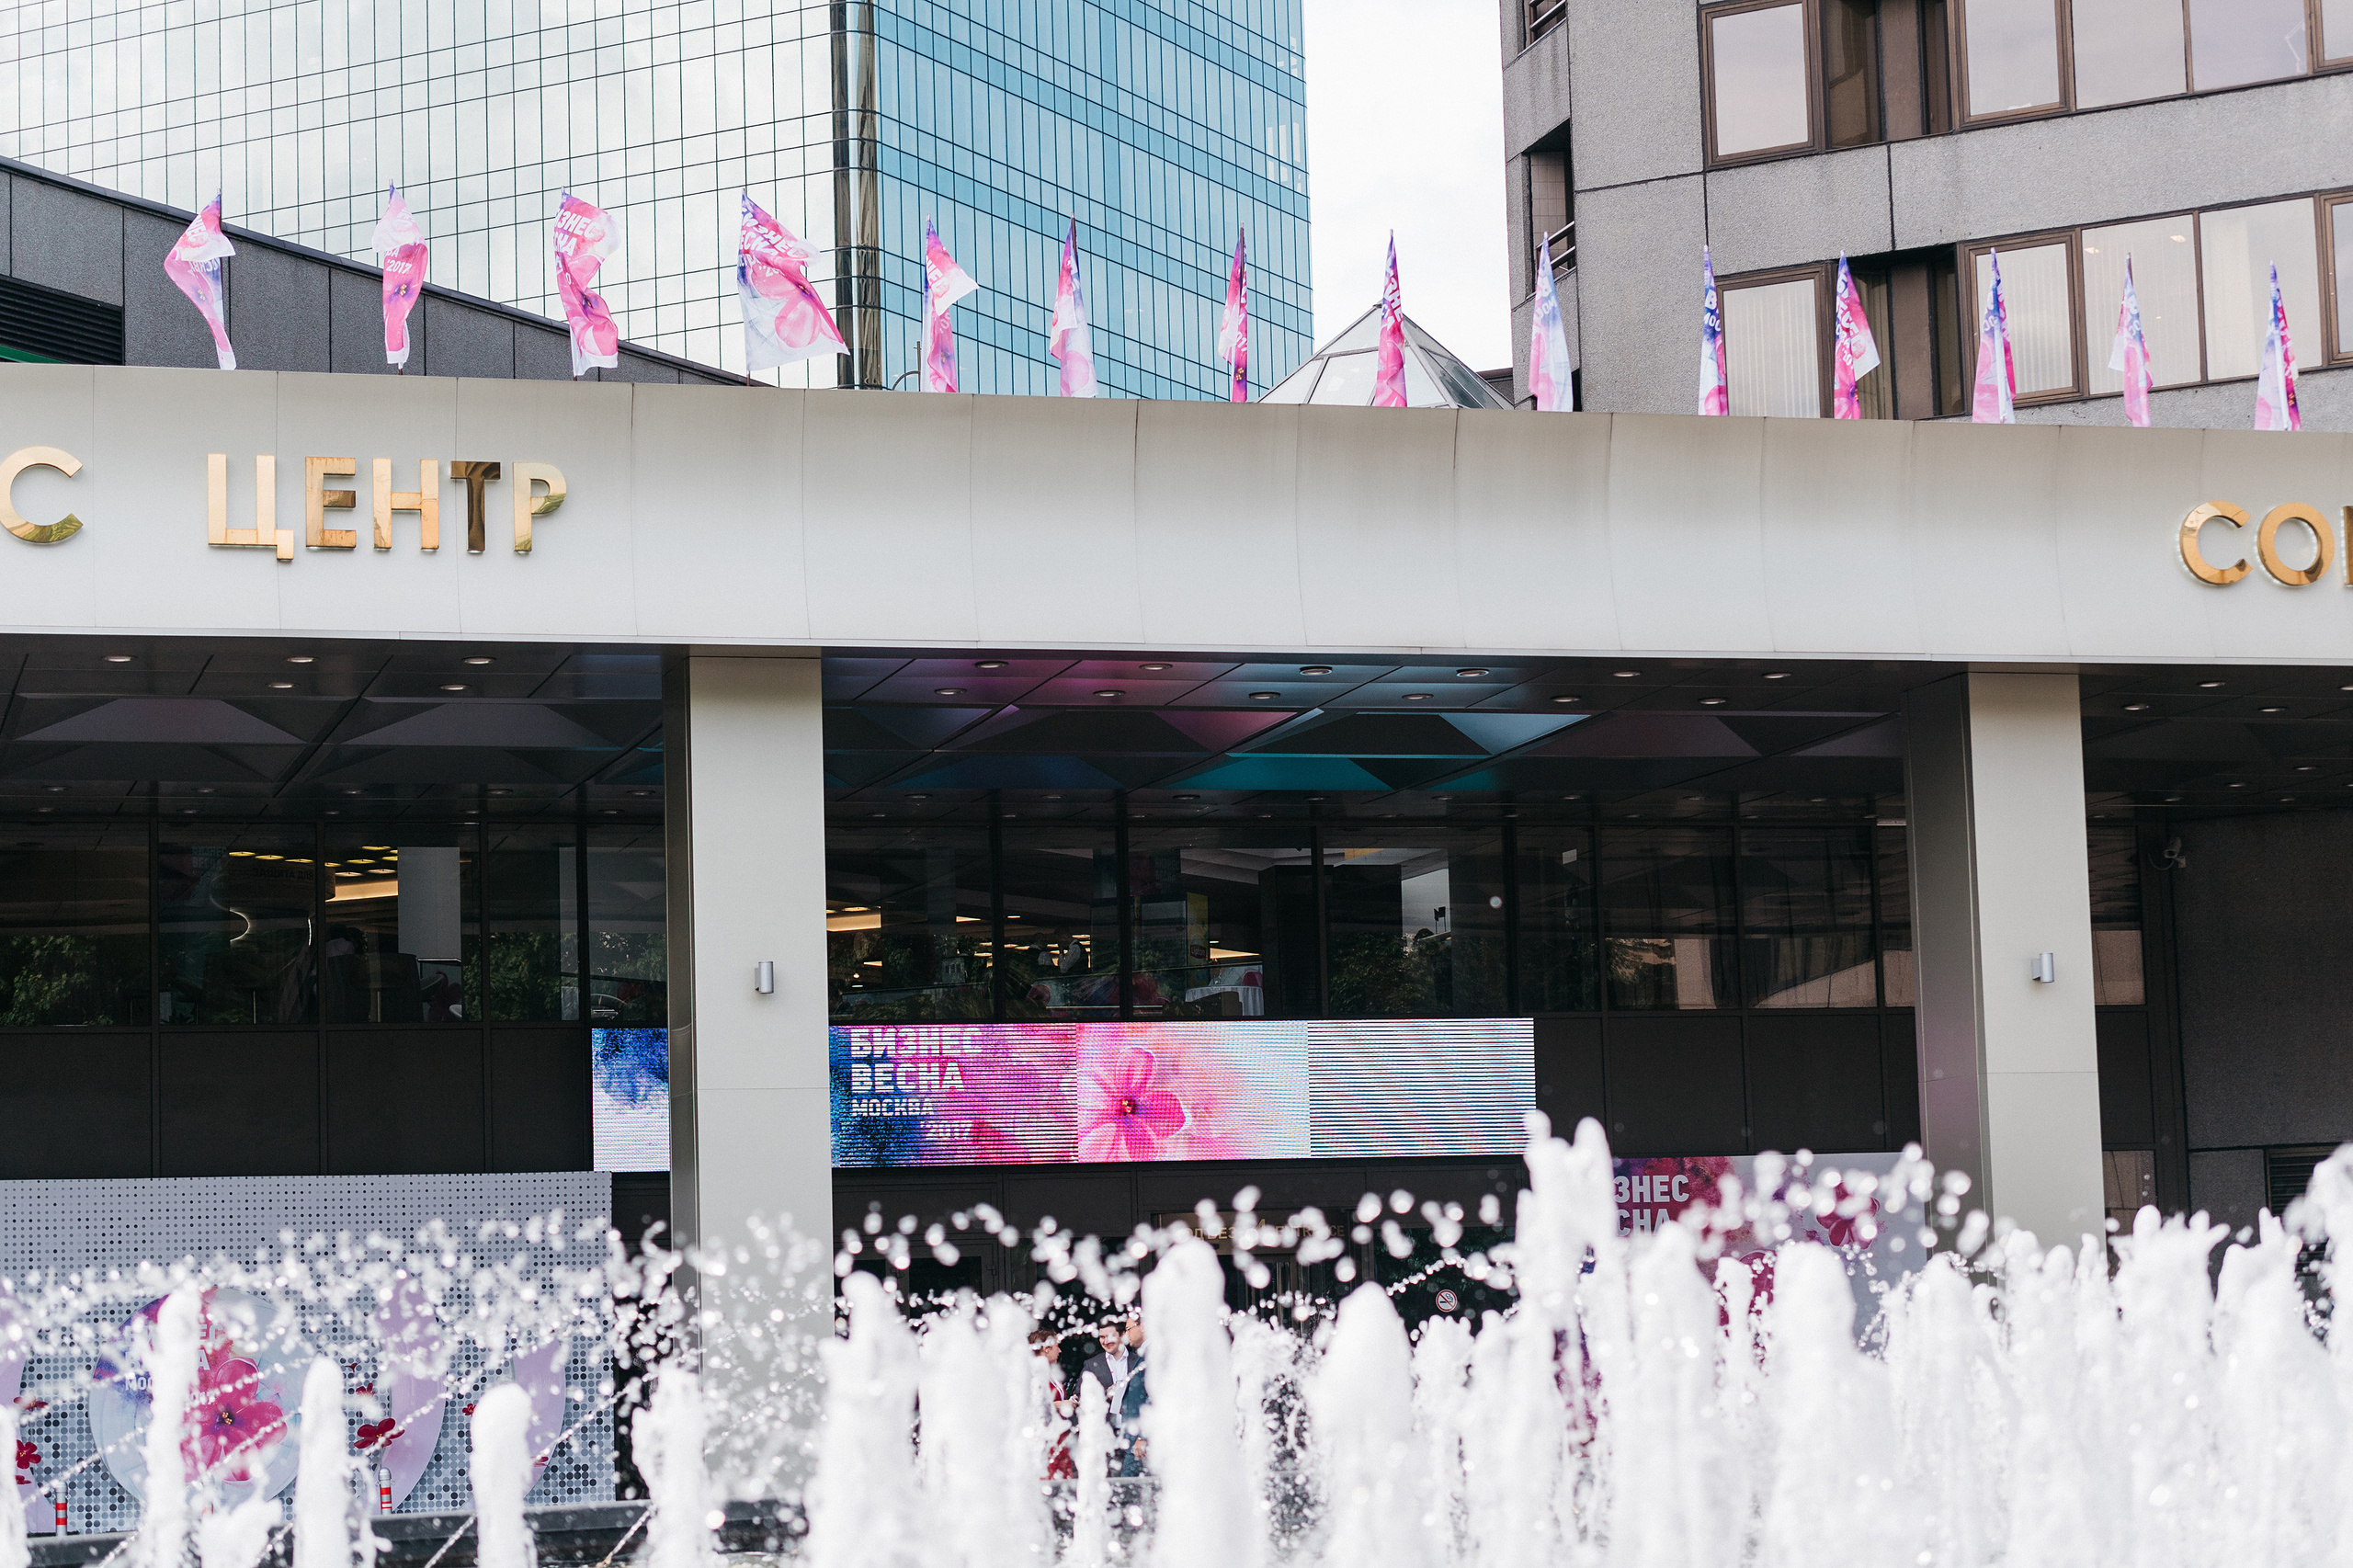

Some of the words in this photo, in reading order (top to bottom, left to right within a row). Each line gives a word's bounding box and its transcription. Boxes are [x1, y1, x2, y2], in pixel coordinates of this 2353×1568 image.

[387, 259, 413, 274] '2017
[0, 447, 84, 543] С
[207, 453, 567, 561] ЦЕНТР
[2177, 500, 2353, 586] CO
[851, 1028, 983, 1058] БИЗНЕС
[851, 1062, 965, 1093] ВЕСНА
[851, 1098, 934, 1117] МОСКВА
